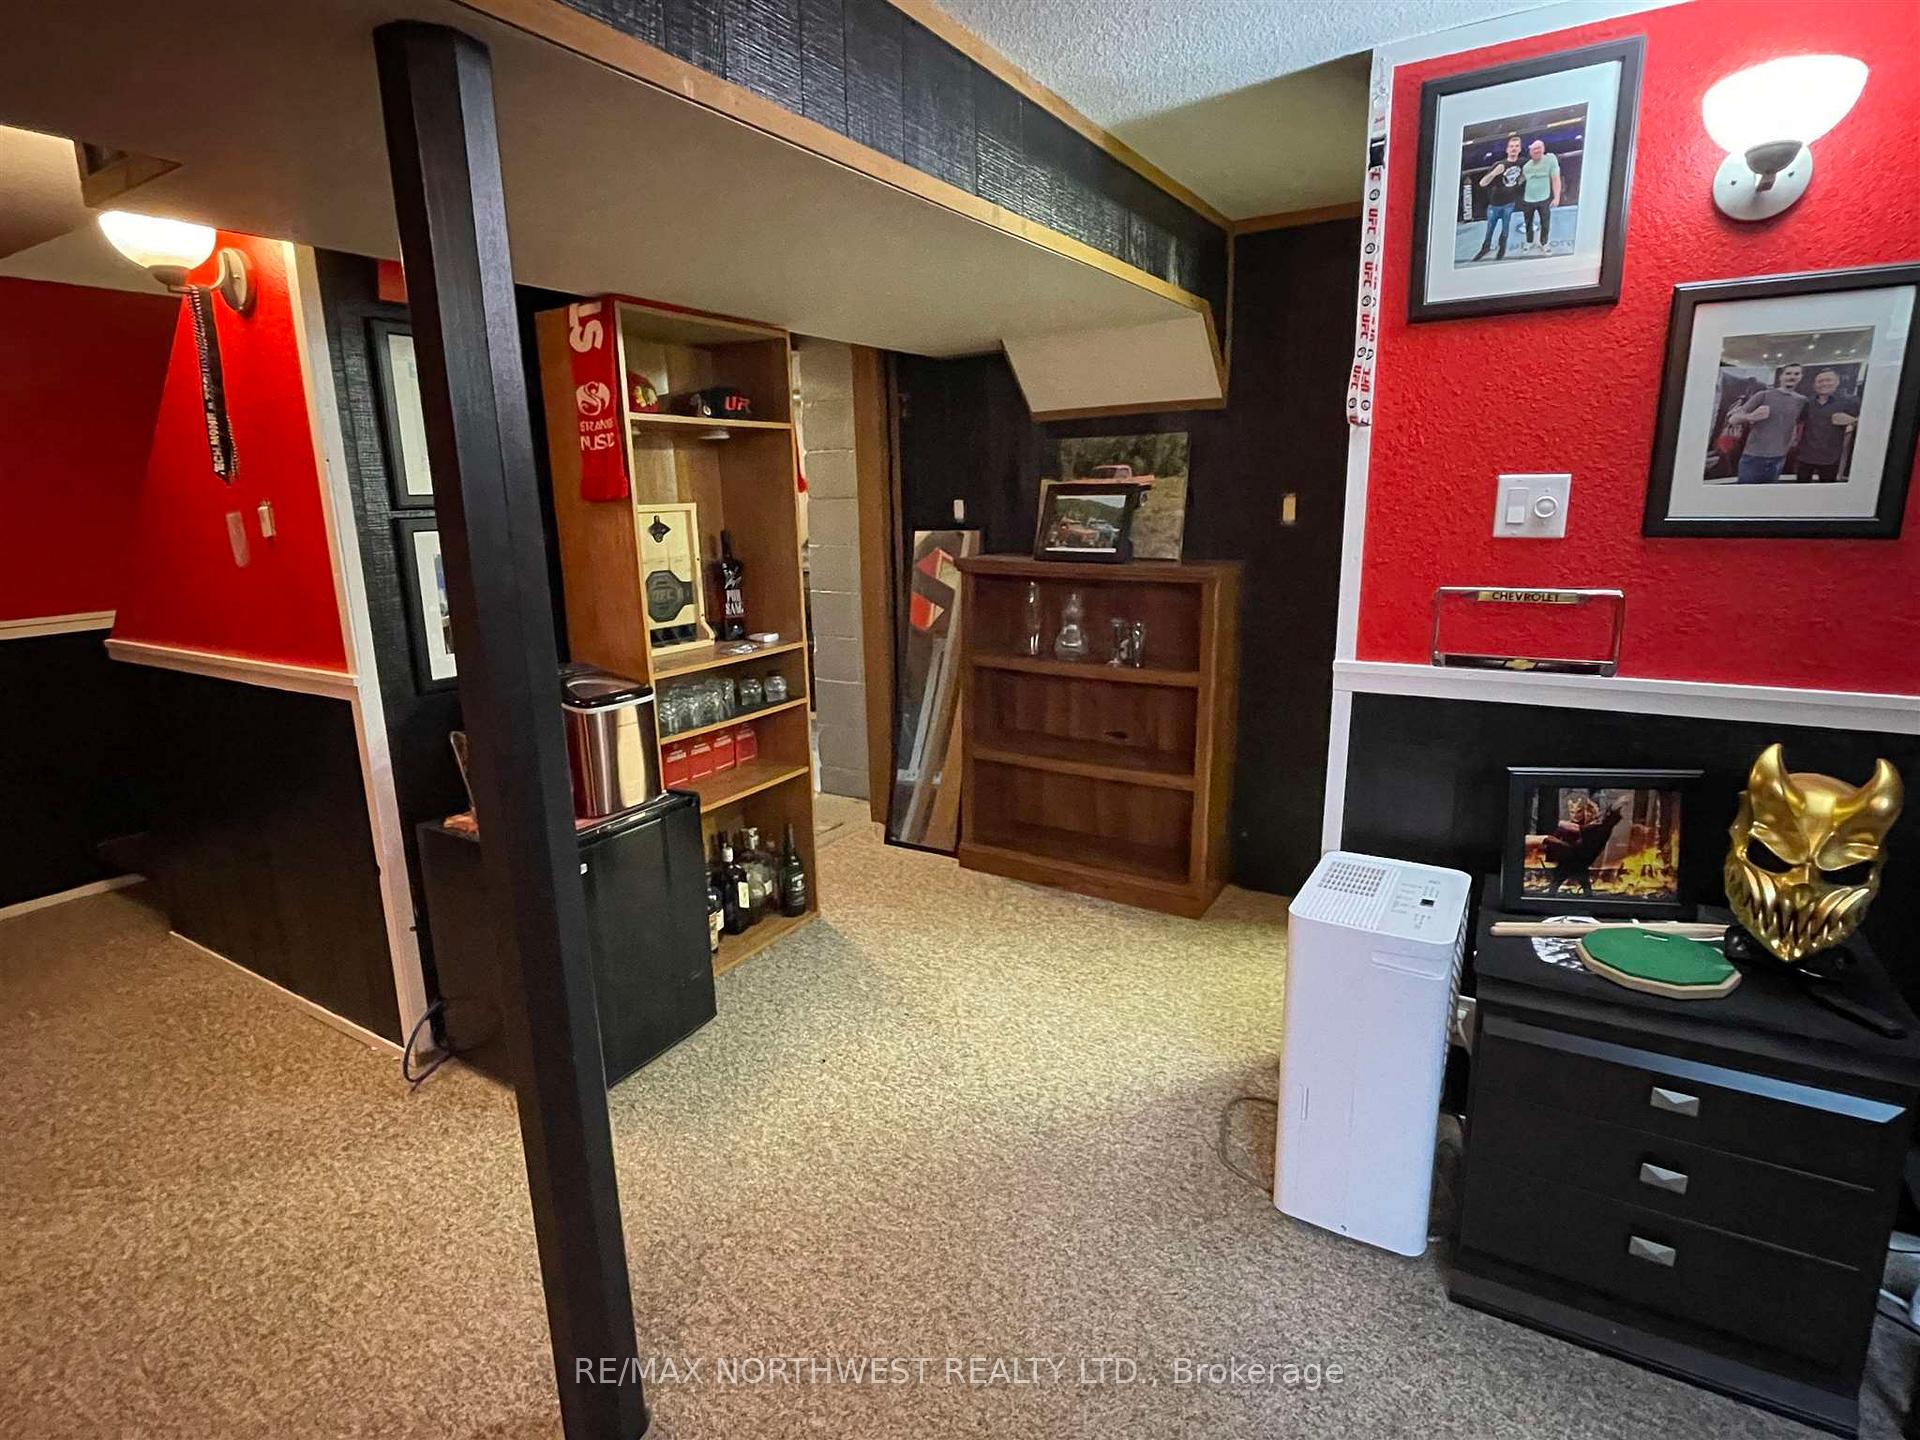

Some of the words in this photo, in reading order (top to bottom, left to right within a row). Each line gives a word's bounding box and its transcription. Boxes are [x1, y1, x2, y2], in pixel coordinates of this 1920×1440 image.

[1366, 208, 1379, 236] UFC
[1362, 261, 1374, 288] UFC
[1359, 313, 1370, 340] UFC
[1350, 364, 1362, 391] UFC
[1491, 591, 1560, 603] CHEVROLET
